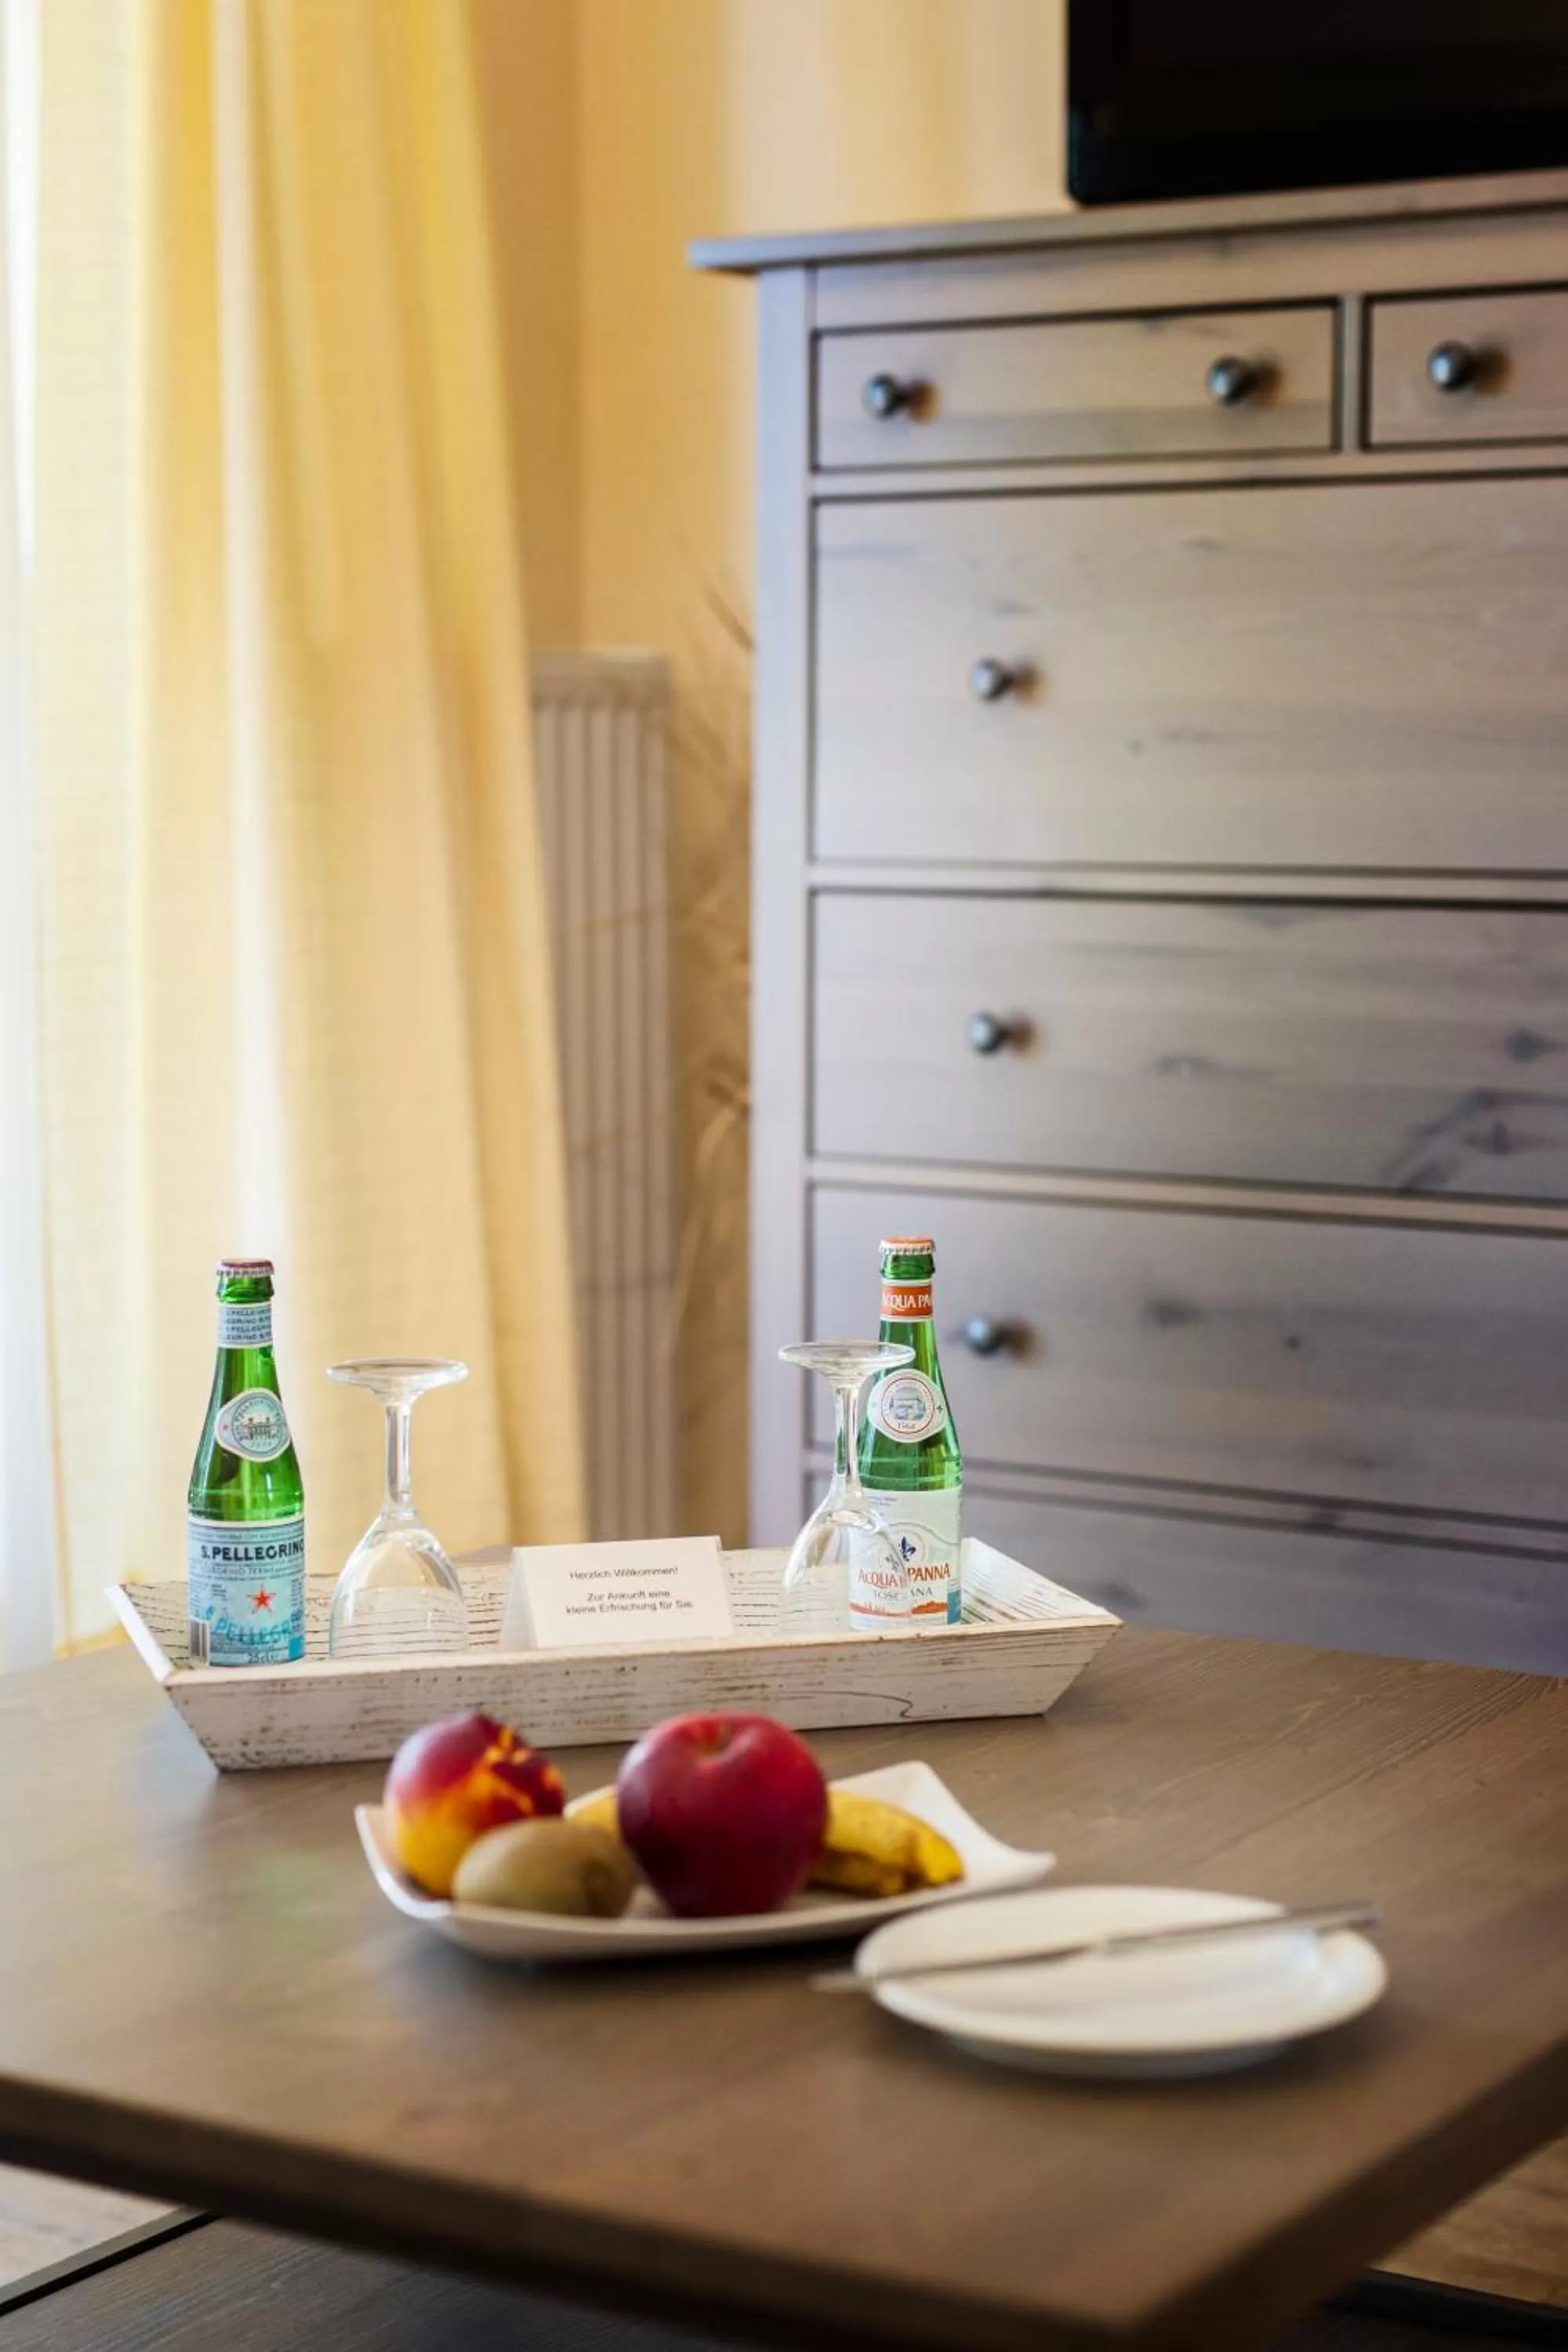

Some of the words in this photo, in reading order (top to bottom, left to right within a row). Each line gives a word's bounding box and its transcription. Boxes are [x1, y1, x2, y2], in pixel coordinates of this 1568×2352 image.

[570, 1570, 612, 1580] Herzlich
[613, 1566, 679, 1578] Willkommen!
[907, 1562, 951, 1582] PANNA
[586, 1592, 604, 1602] Zur
[607, 1590, 646, 1601] Ankunft
[565, 1605, 596, 1614] kleine
[599, 1602, 657, 1613] Erfrischung
